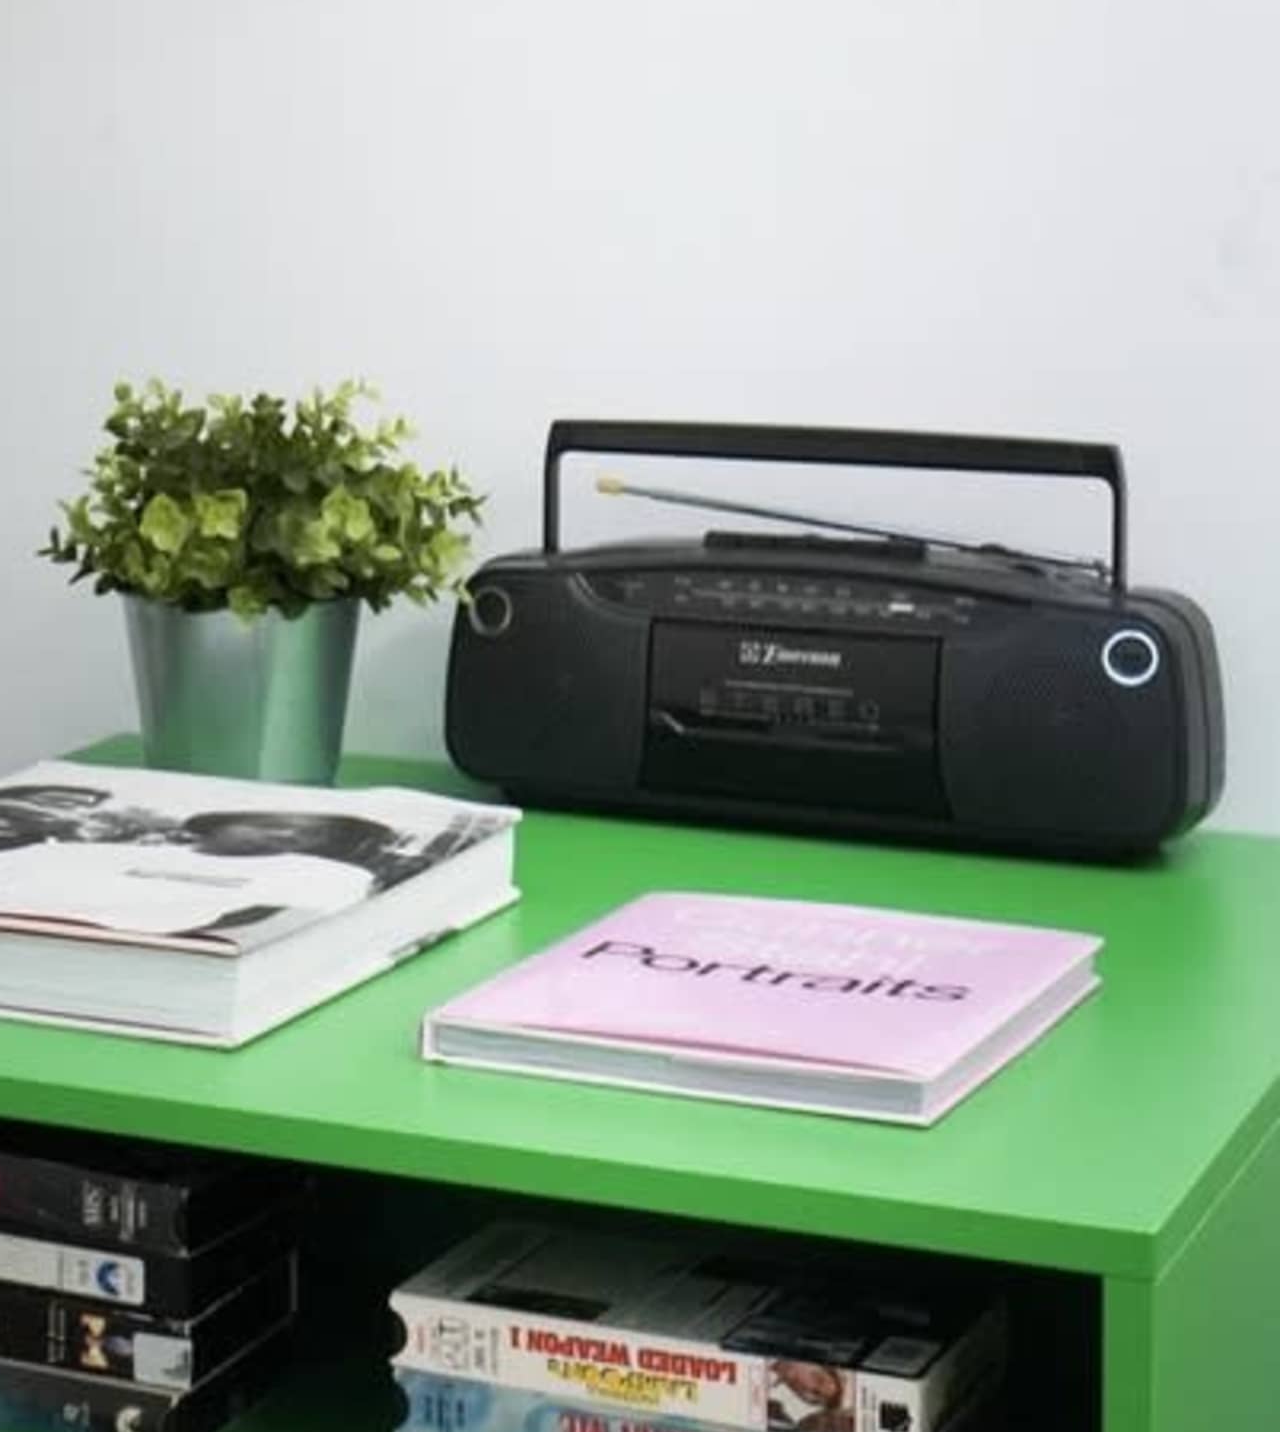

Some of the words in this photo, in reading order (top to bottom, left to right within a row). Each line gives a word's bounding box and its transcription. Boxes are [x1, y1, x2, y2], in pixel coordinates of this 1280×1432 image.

[580, 940, 971, 1001] Portraits
[526, 1329, 631, 1367] WEAPON
[637, 1346, 738, 1385] LOADED
